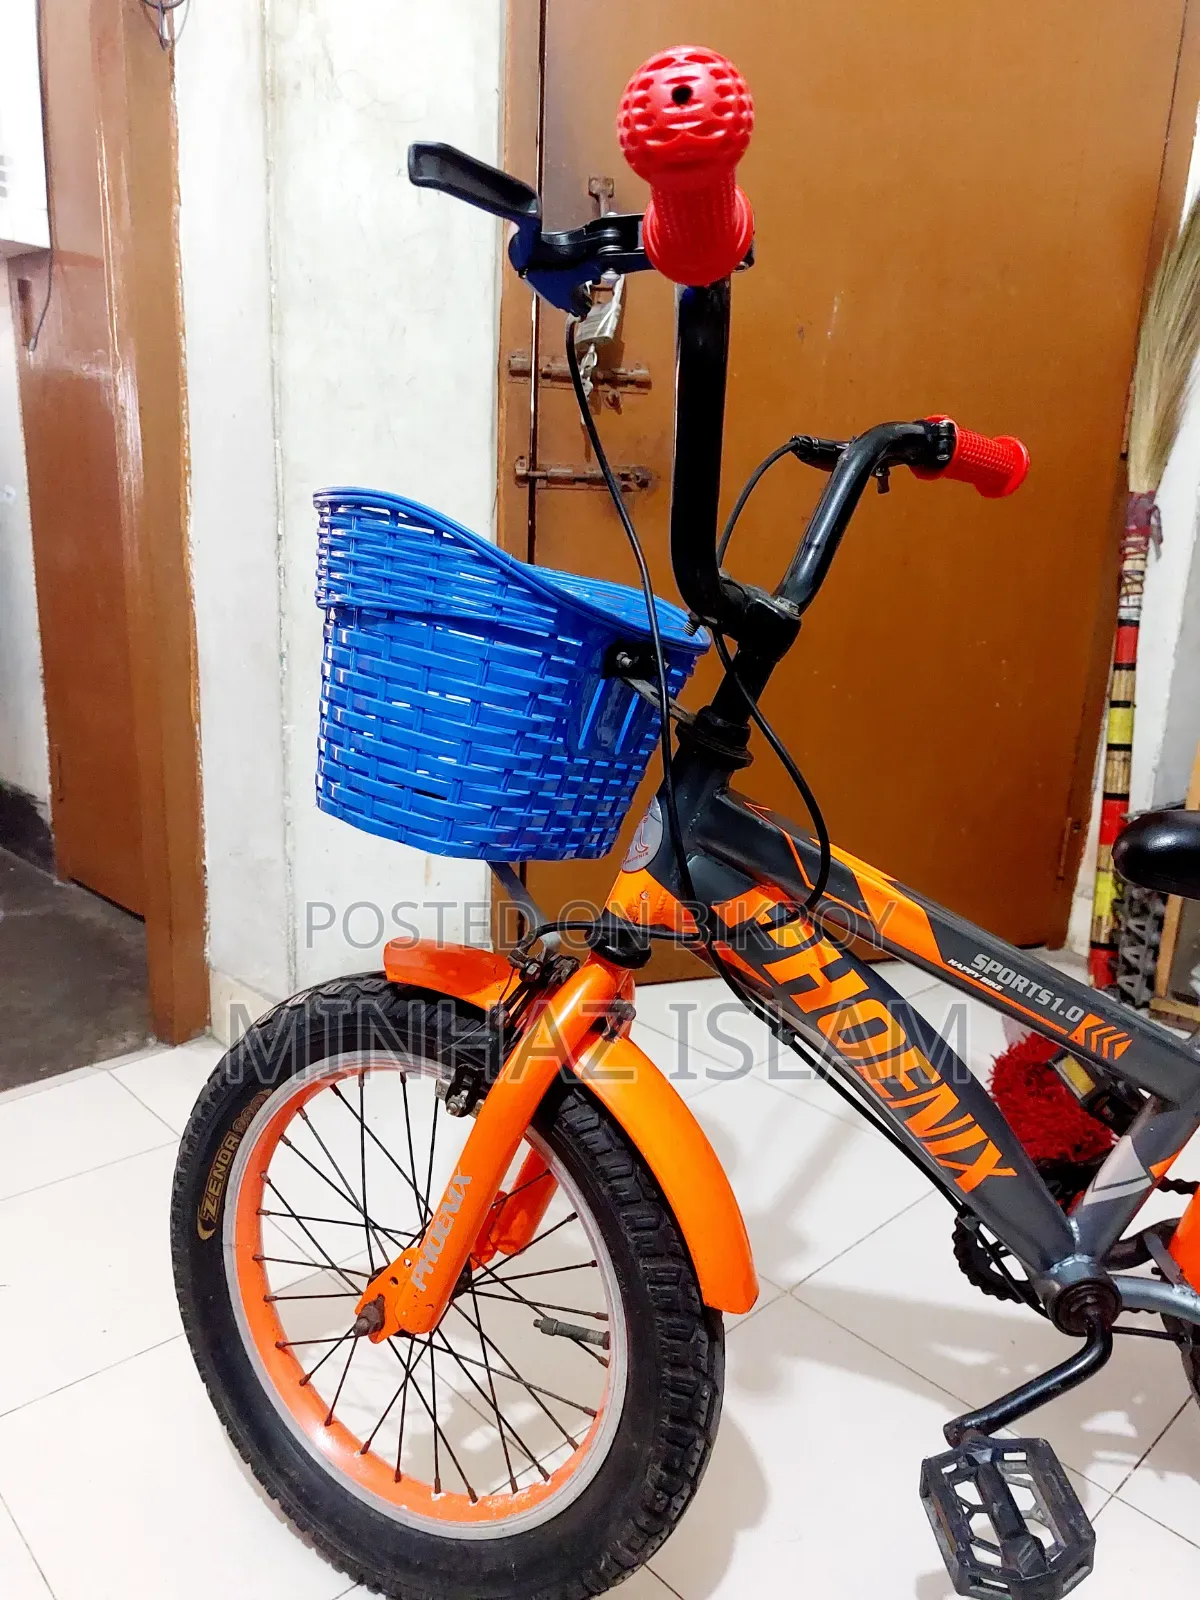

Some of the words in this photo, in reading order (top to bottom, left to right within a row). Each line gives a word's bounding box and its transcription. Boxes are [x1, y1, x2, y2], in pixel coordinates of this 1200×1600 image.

[711, 884, 1017, 1193] PHOENIX
[947, 959, 984, 979] HAPPY
[979, 973, 1004, 991] BIKE
[411, 1165, 472, 1292] PHOENIX
